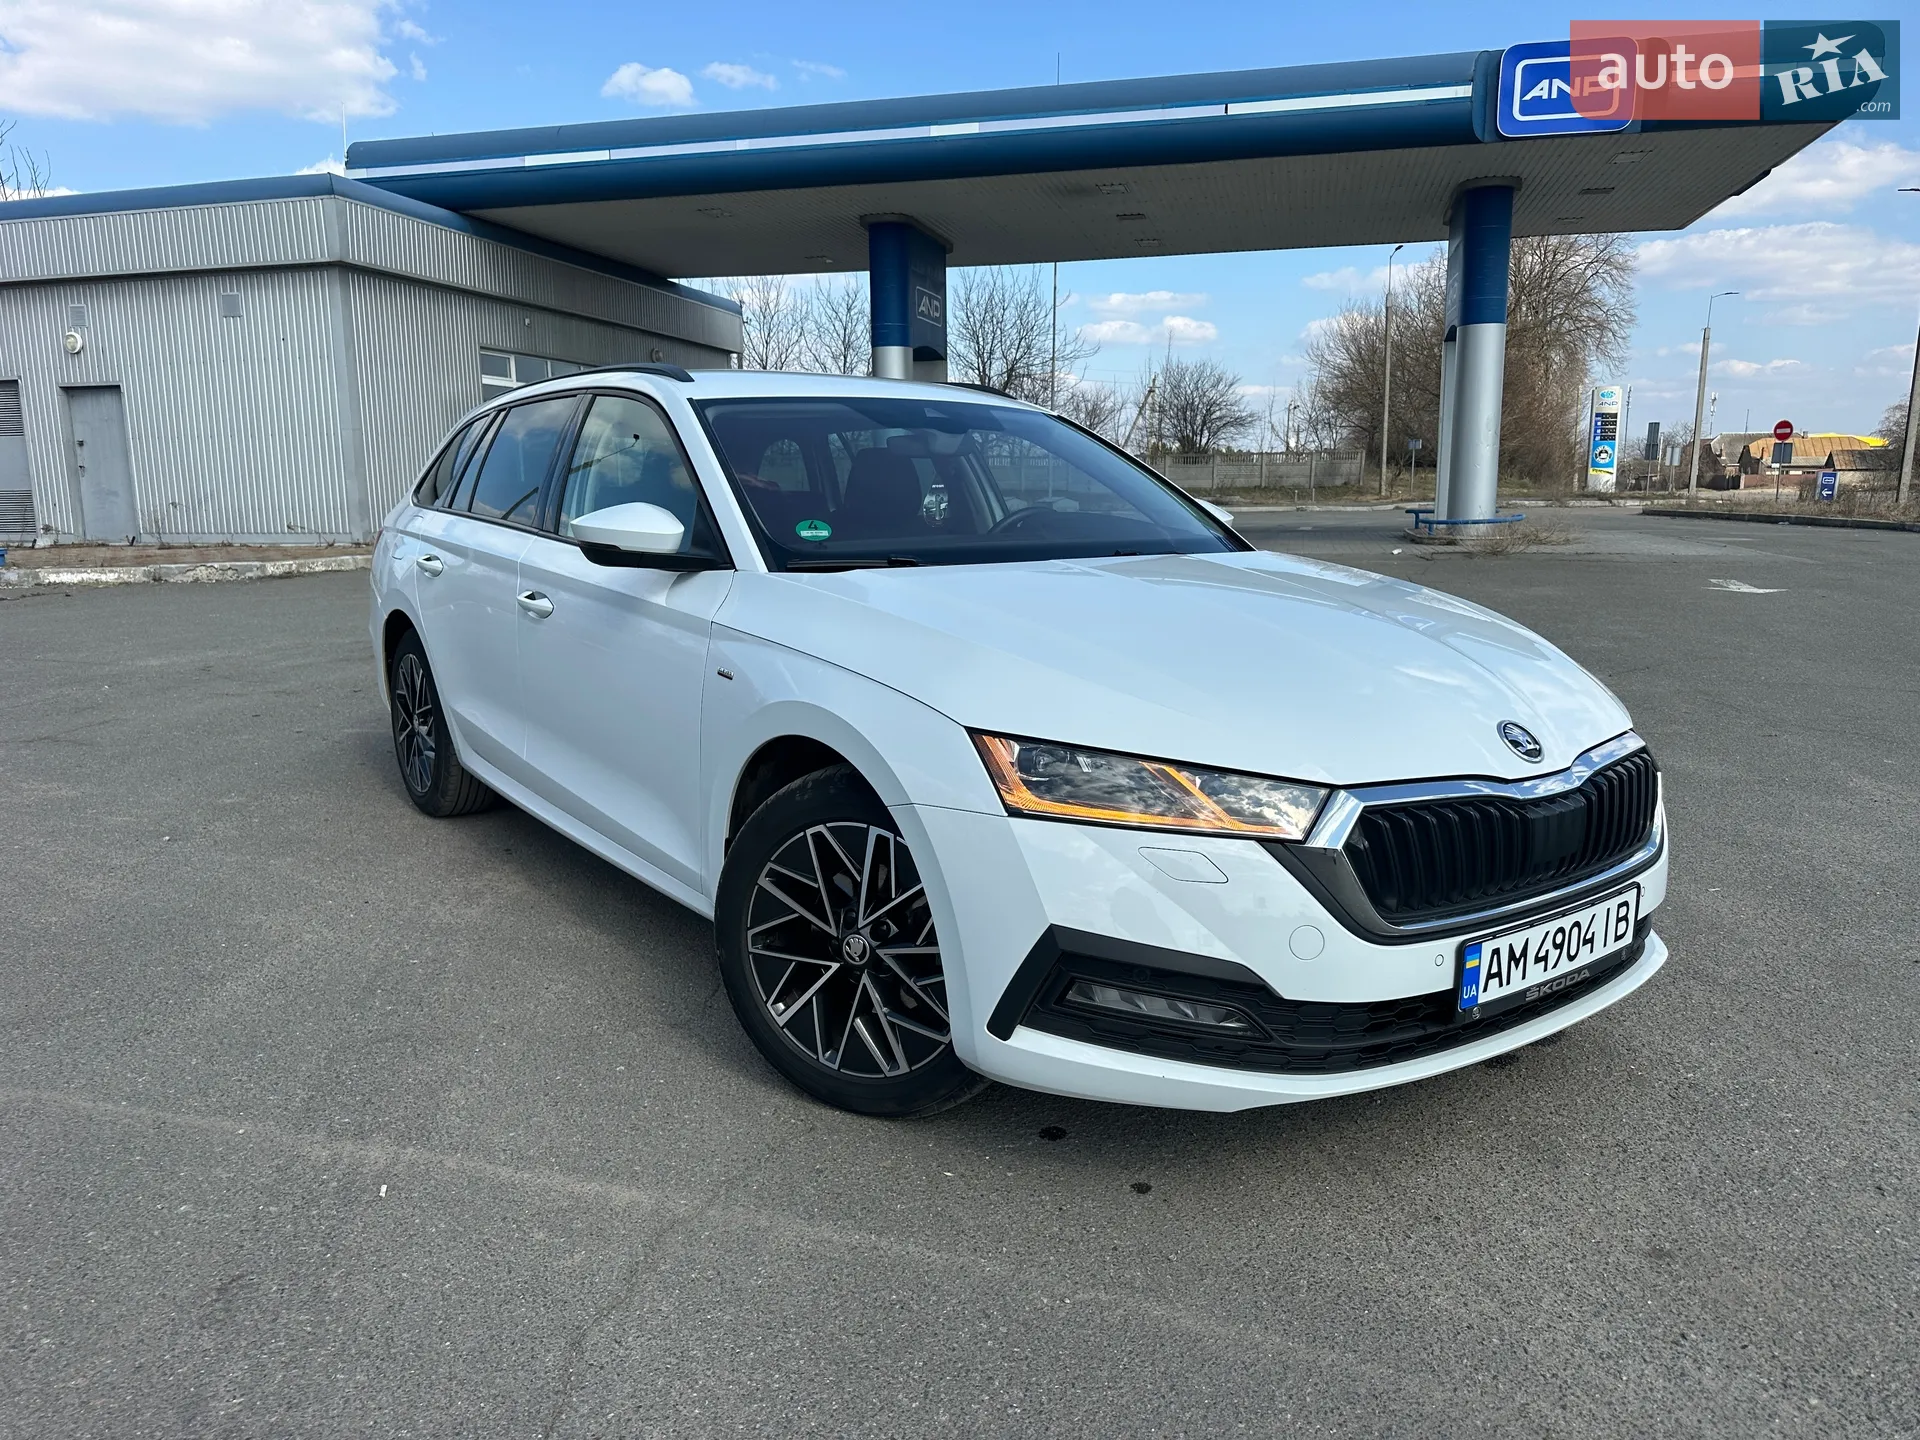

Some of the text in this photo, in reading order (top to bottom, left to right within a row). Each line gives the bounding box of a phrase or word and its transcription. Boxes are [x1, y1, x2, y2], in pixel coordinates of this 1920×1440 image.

[918, 295, 941, 318] ANP
[807, 520, 818, 530] 4
[1482, 900, 1630, 993] AM 4904 IB
[1463, 984, 1477, 999] UA
